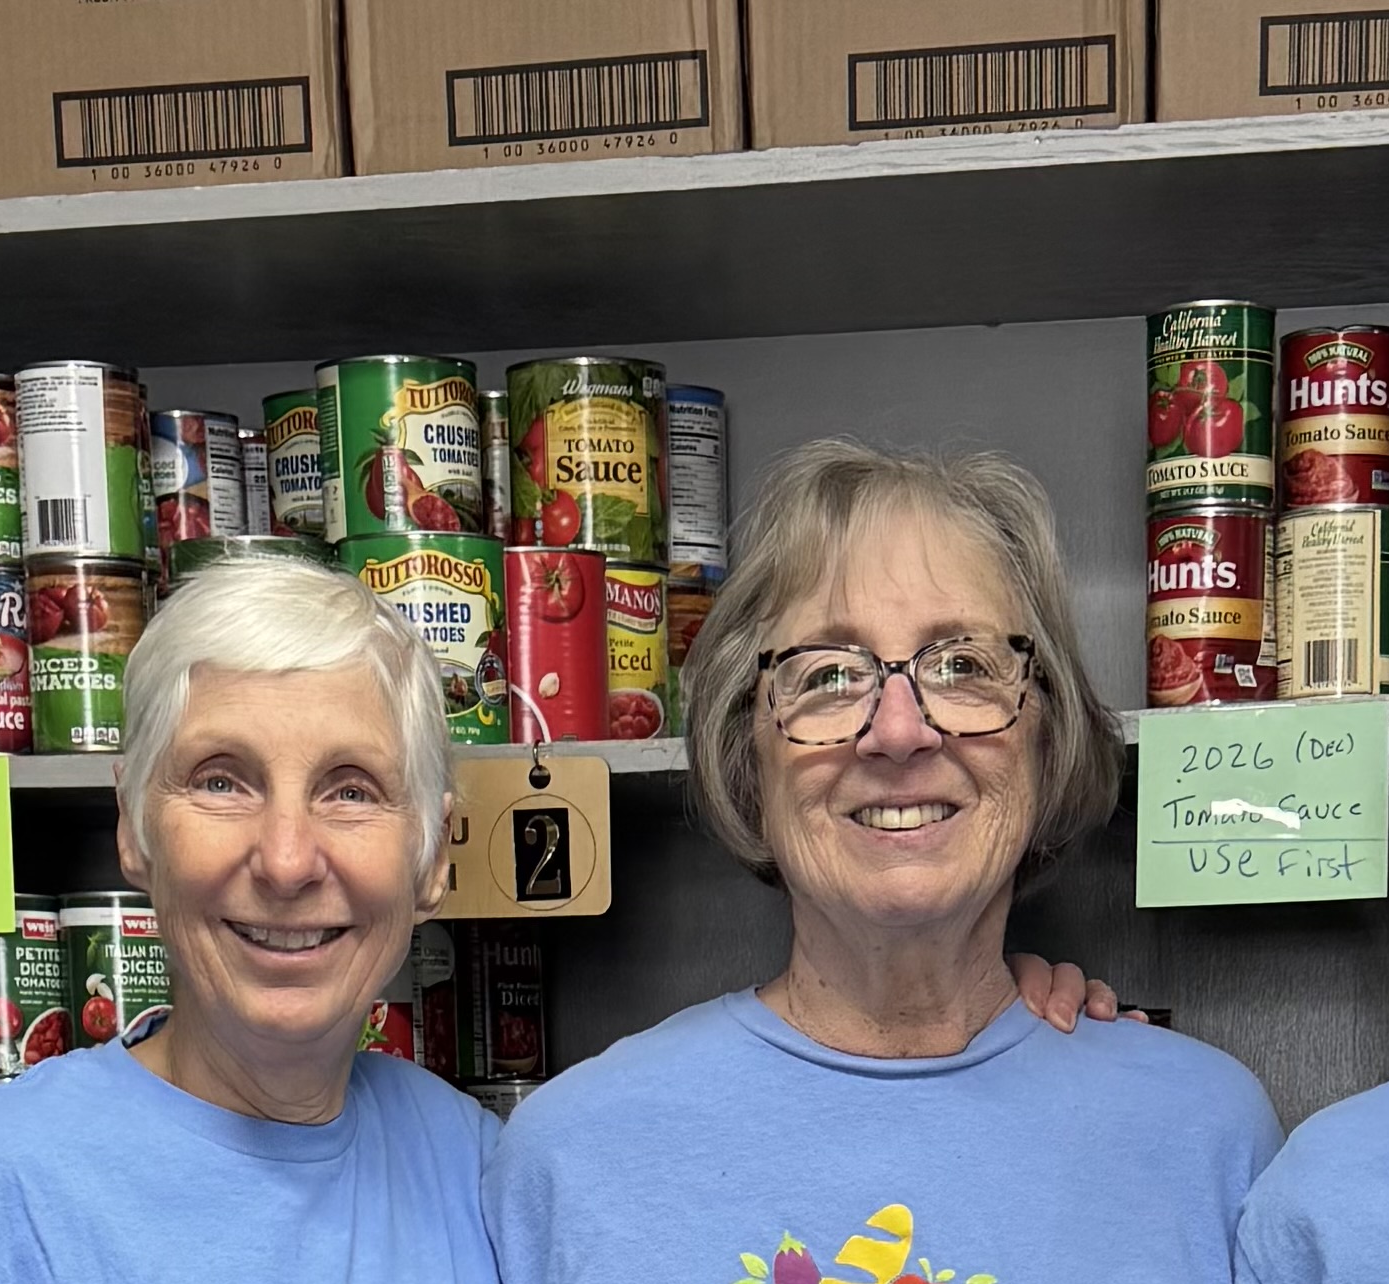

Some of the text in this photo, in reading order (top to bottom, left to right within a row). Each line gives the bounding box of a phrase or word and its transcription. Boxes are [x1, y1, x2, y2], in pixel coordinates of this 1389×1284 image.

[112, 165, 131, 179] 00
[143, 162, 195, 178] 36000
[209, 159, 260, 174] 47926
[563, 378, 633, 397] Wegmans
[565, 438, 634, 454] TOMATO
[1285, 426, 1341, 447] Tomato
[555, 454, 643, 485] Sauce
[1200, 462, 1249, 480] SAUCE
[366, 554, 485, 590] TUTTOROSSO
[1188, 607, 1242, 626] Sauce
[1182, 742, 1273, 773] 2026
[525, 816, 562, 896] 2
